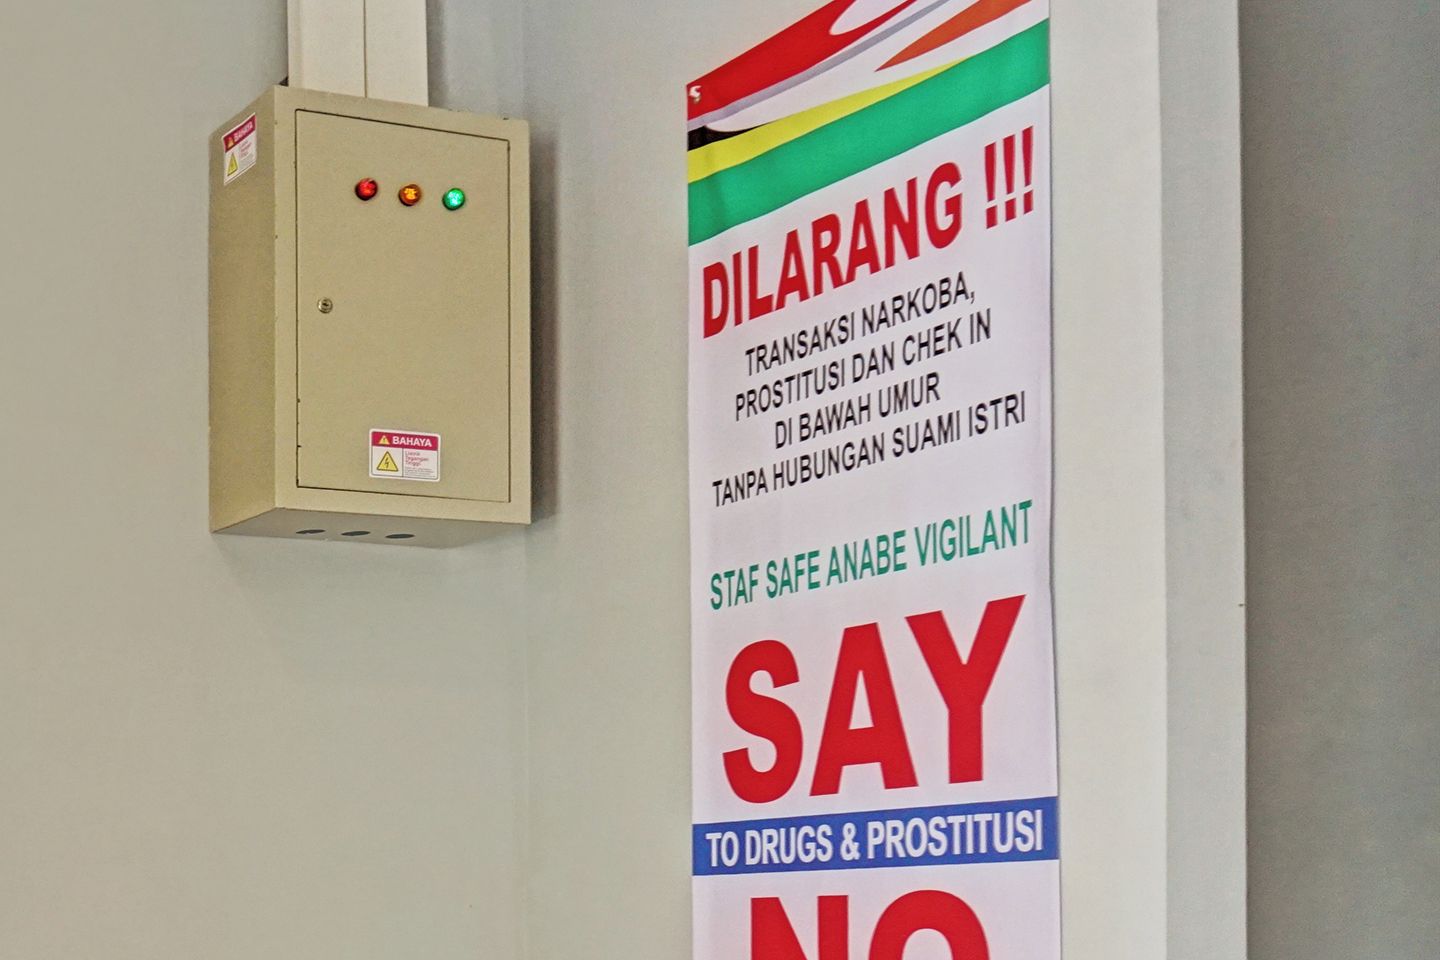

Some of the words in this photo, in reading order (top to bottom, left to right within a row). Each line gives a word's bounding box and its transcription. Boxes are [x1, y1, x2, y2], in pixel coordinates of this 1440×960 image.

[702, 161, 963, 339] DILARANG
[984, 125, 1034, 230] !!!
[735, 358, 846, 422] PROSTITUSI
[852, 341, 895, 384] DAN
[902, 317, 963, 366] CHEK
[969, 307, 992, 345] IN
[744, 311, 856, 377] TRANSAKSI
[861, 270, 975, 337] NARKOBA,
[392, 435, 433, 447] BAHAYA
[711, 466, 769, 508] TANPA
[773, 432, 886, 491] HUBUNGAN
[891, 409, 961, 458] SUAMI
[968, 390, 1026, 437] ISTRI
[774, 417, 793, 449] DI
[799, 393, 871, 443] BAWAH
[877, 371, 941, 418] UMUR
[709, 563, 760, 611] STAF
[765, 549, 821, 600] SAFE
[826, 529, 907, 586] ANABE
[914, 499, 1033, 567] VIGILANT
[722, 593, 1027, 804] SAY
[705, 831, 739, 867] TO
[745, 823, 834, 866] DRUGS
[839, 822, 861, 861] &
[866, 809, 1043, 860] PROSTITUSI
